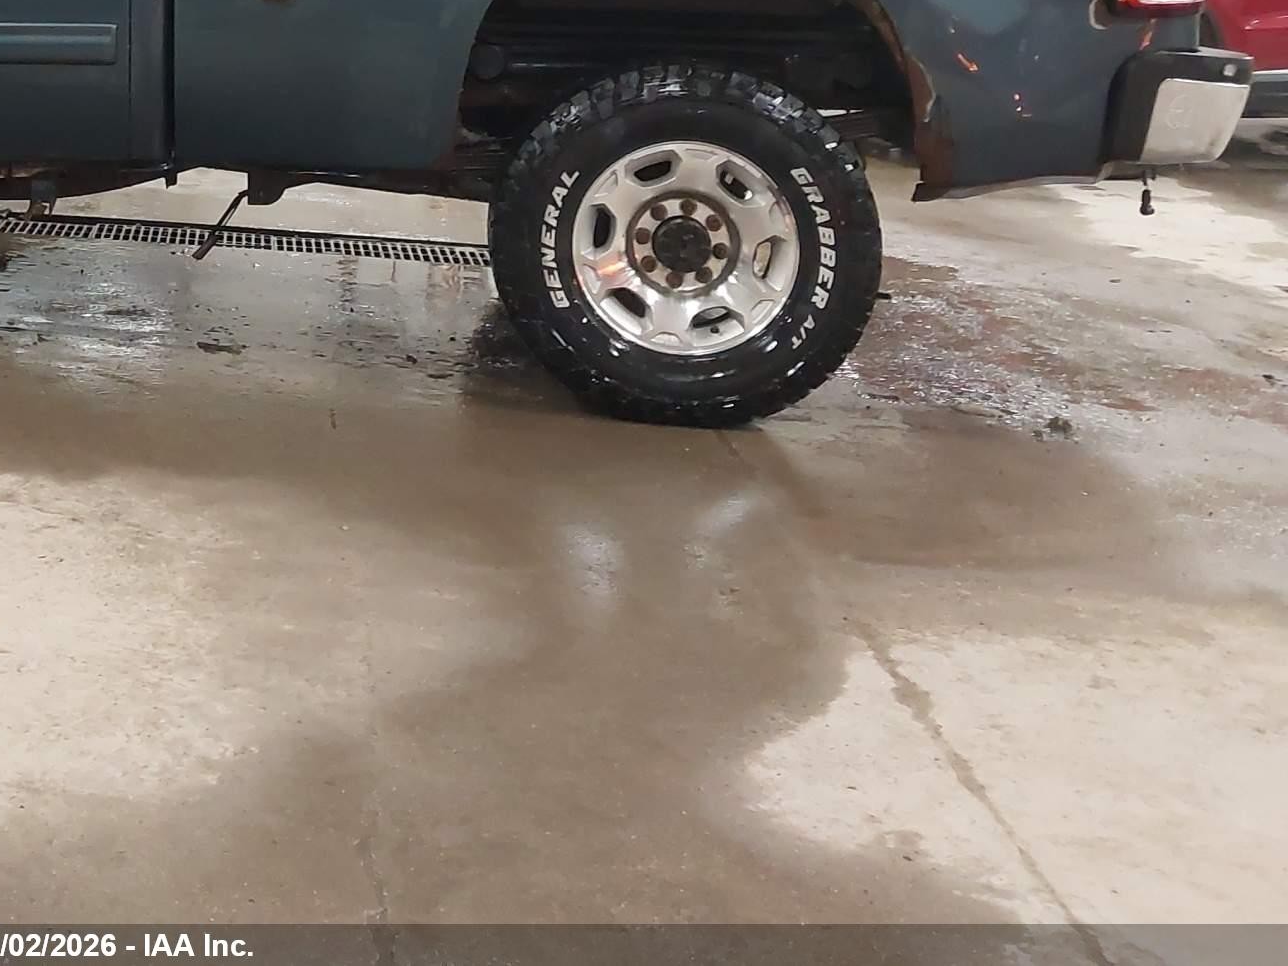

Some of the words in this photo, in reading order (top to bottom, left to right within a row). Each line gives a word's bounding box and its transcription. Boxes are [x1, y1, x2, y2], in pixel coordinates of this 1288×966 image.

[540, 169, 580, 309] GENERAL
[790, 166, 838, 310] GRABBER
[791, 313, 816, 350] A/T
